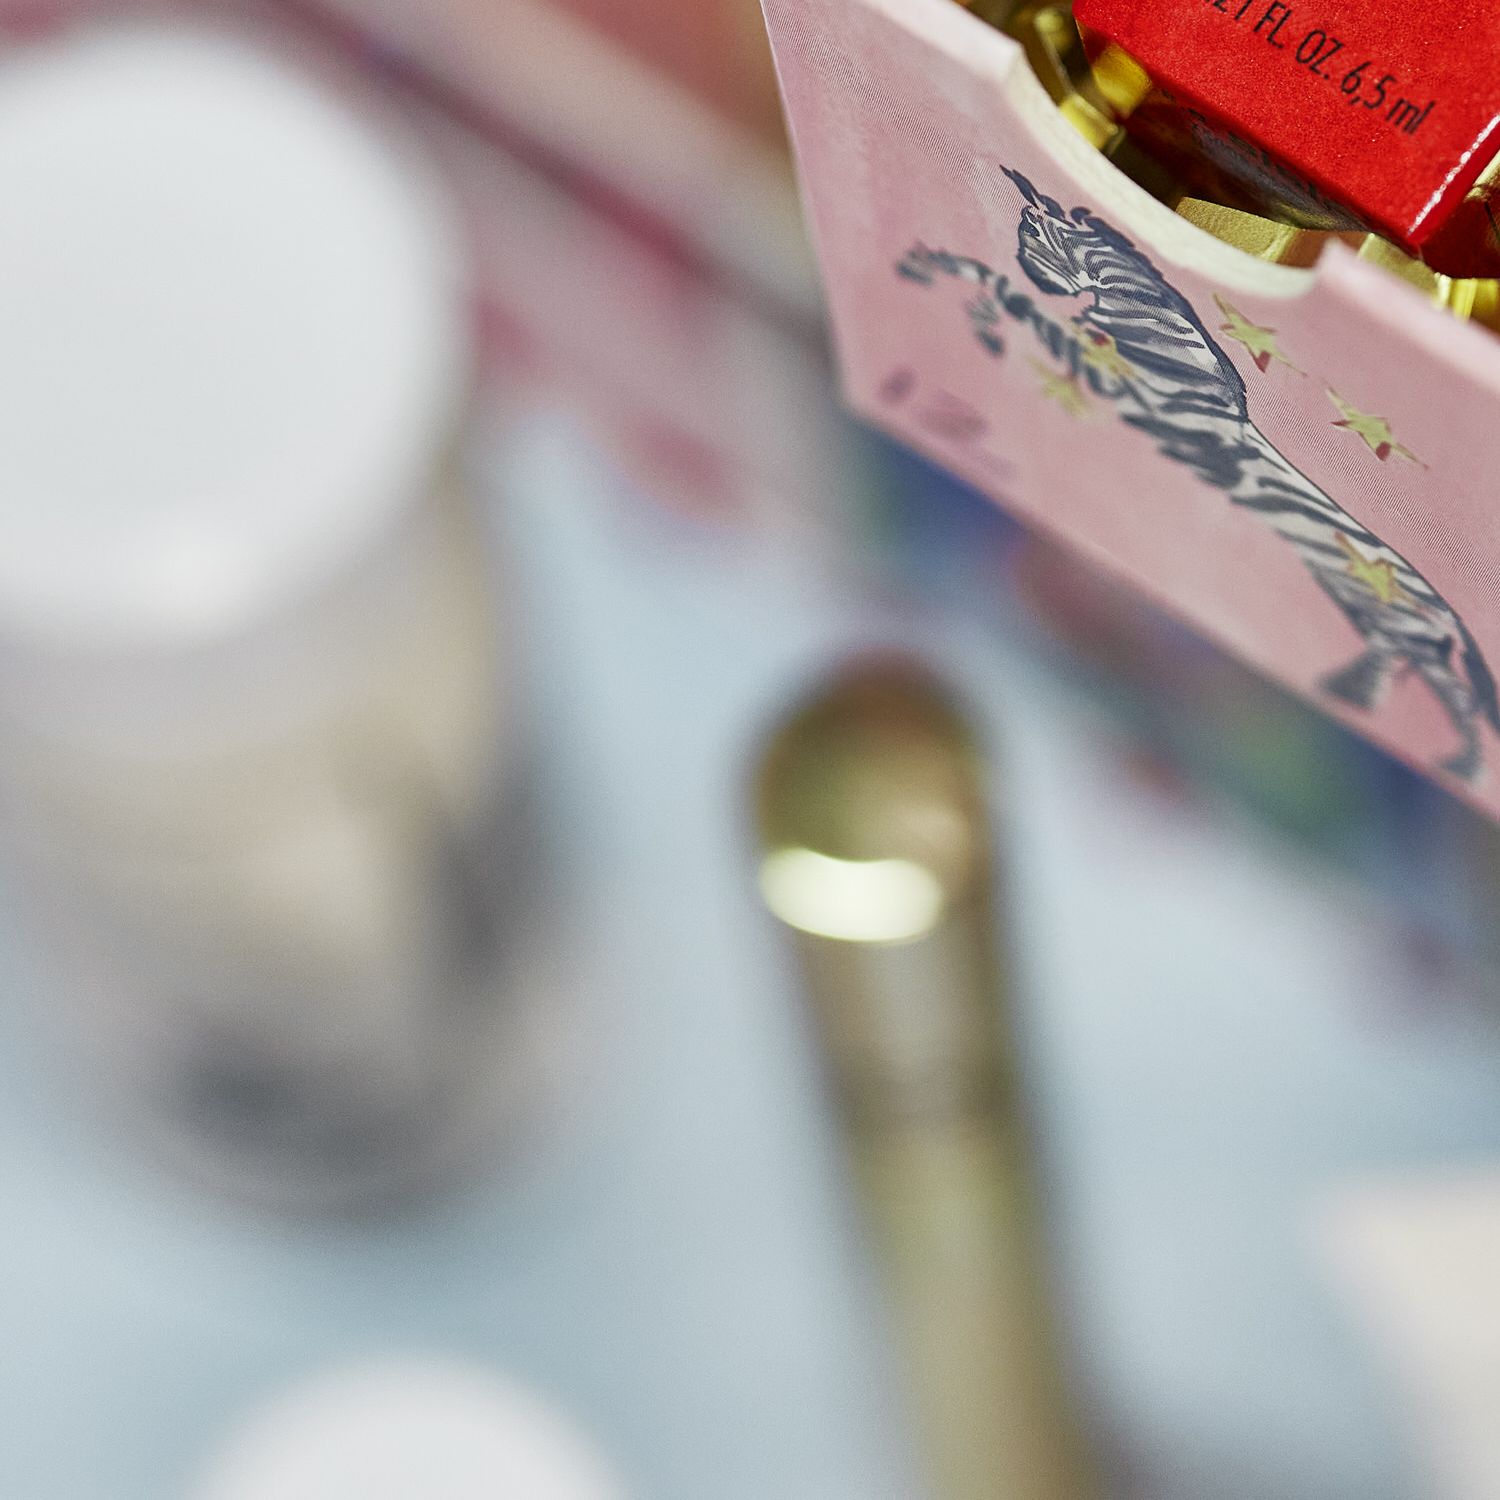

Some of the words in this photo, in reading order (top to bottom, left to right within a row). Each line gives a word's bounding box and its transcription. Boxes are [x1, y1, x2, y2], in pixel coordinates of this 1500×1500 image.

[1296, 30, 1344, 81] OZ.
[1341, 62, 1397, 111] 6,5
[1385, 101, 1435, 136] ml
